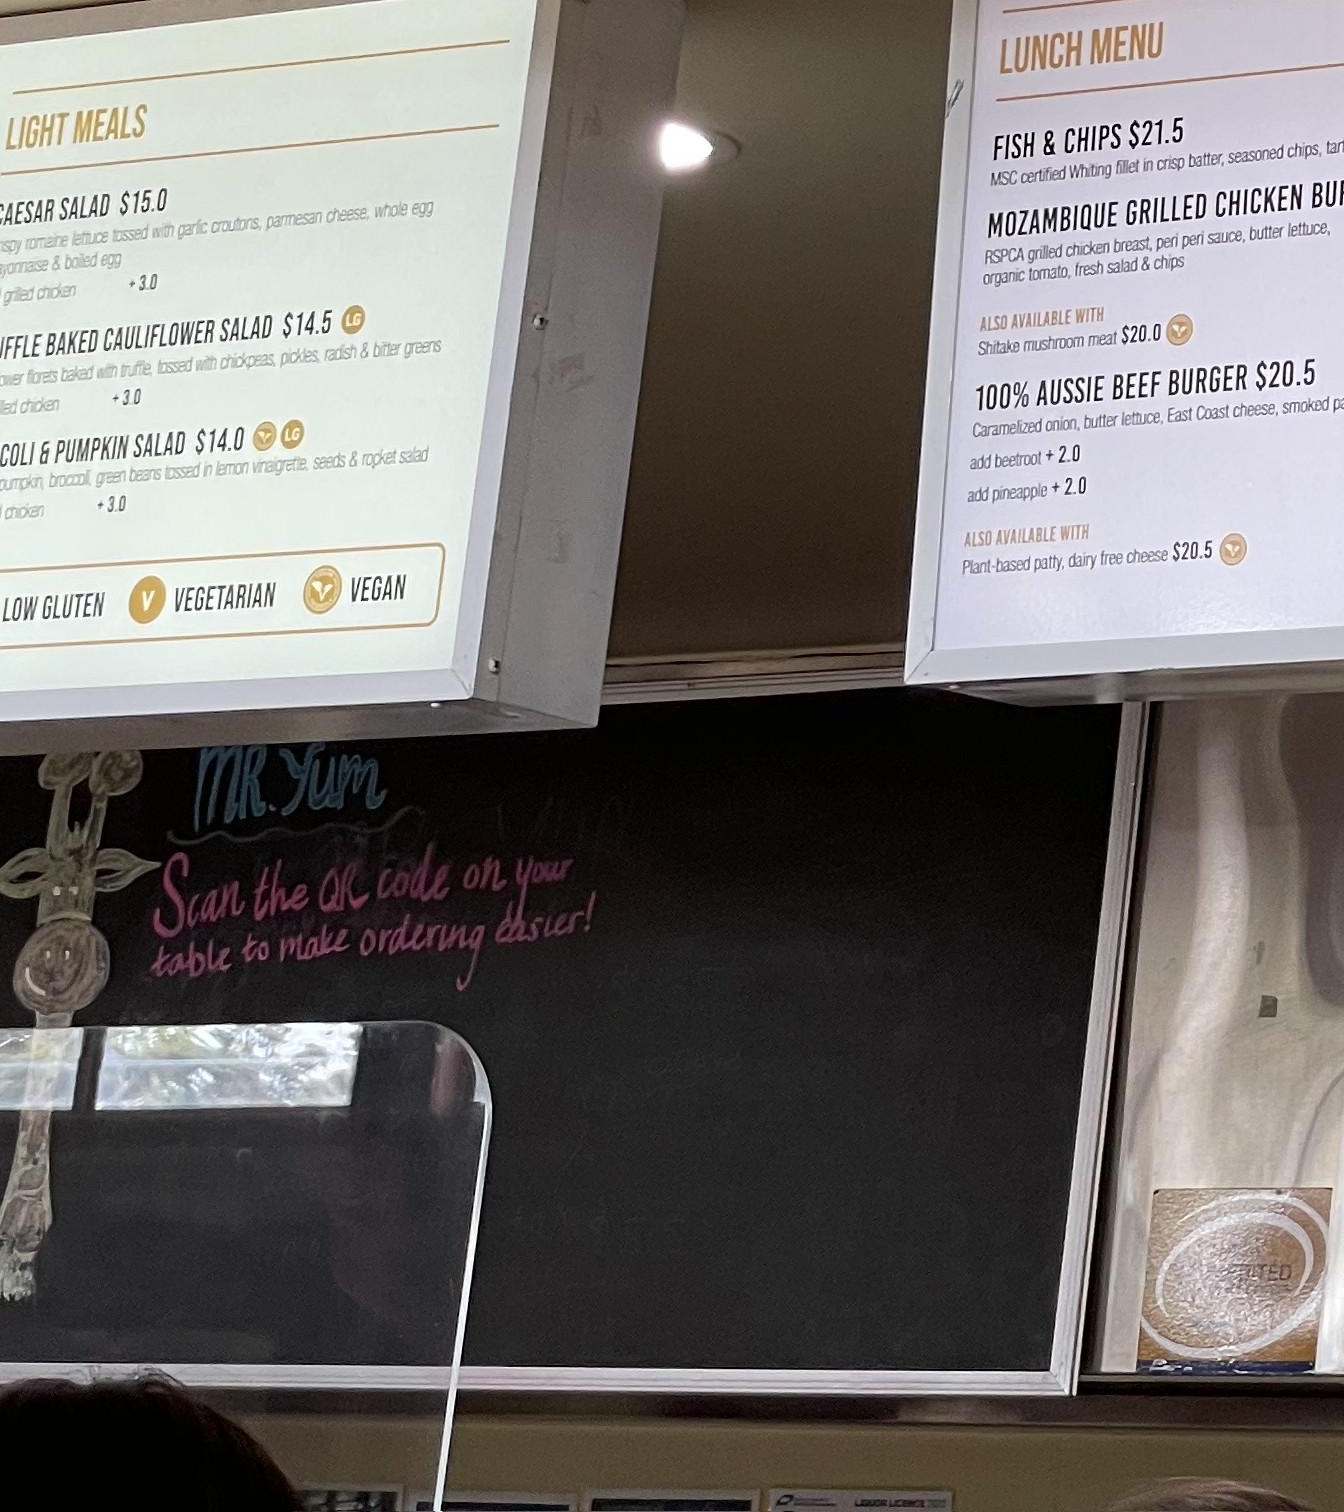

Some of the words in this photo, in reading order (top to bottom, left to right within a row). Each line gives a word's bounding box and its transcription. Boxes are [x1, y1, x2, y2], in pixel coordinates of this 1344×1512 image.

[999, 30, 1083, 74] LUNCH
[1089, 21, 1164, 65] MENU
[5, 112, 70, 151] LIGHT
[72, 103, 148, 144] MEALS
[992, 131, 1036, 161] FISH
[1042, 129, 1056, 156] &
[1064, 123, 1122, 154] CHIPS
[1128, 116, 1184, 150] $21.5
[58, 193, 111, 221] SALAD
[119, 187, 168, 217] $15.0
[987, 201, 1119, 239] MOZAMBIQUE
[1125, 193, 1208, 226] GRILLED
[1215, 183, 1304, 218] CHICKEN
[45, 329, 99, 357] BAKED
[103, 319, 216, 352] CAULIFLOWER
[219, 314, 273, 342] SALAD
[282, 309, 333, 340] $14.5
[977, 339, 1020, 356] Shitake
[1023, 335, 1085, 352] mushroom
[1087, 330, 1118, 347] meat
[1121, 323, 1162, 346] $20.0
[979, 314, 1008, 333] ALSO
[1010, 308, 1073, 330] AVAILABLE
[1074, 306, 1105, 324] WITH
[975, 380, 1030, 412] 100%
[1036, 375, 1106, 407] AUSSIE
[1112, 370, 1162, 401] BEEF
[1168, 364, 1248, 396] BURGER
[1255, 358, 1316, 392] $20.5
[39, 440, 50, 466] &
[54, 434, 130, 464] PUMPKIN
[132, 430, 186, 458] SALAD
[195, 426, 245, 456] $14.0
[969, 454, 992, 470] add
[994, 450, 1042, 468] beetroot
[1058, 444, 1081, 464] 2.0
[2, 596, 39, 622] LOW
[42, 591, 106, 620] GLUTEN
[174, 582, 277, 613] VEGETARIAN
[351, 574, 407, 603] VEGAN
[153, 851, 245, 938] Scan
[253, 858, 310, 921] the
[318, 864, 369, 913] QR
[376, 841, 450, 902] code
[463, 856, 508, 892] on
[516, 855, 574, 921] your
[151, 944, 233, 978] table
[241, 933, 270, 963] to
[279, 924, 350, 963] make
[359, 912, 486, 992] ordering
